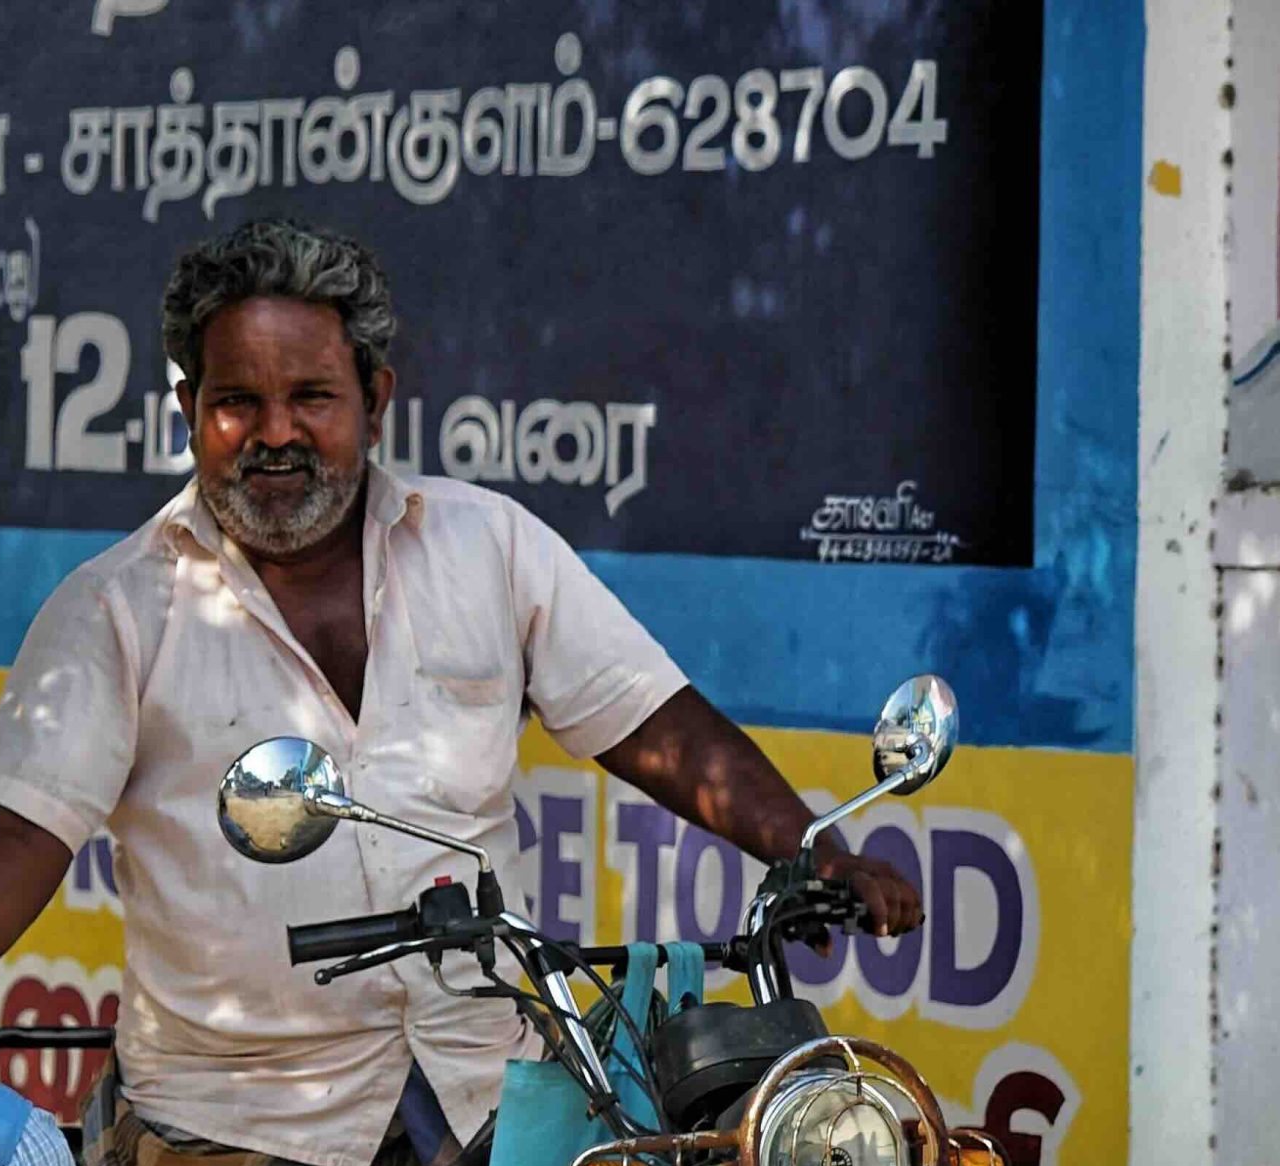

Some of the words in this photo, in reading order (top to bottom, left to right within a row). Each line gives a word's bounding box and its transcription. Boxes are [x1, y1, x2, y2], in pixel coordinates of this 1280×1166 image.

[61, 33, 949, 222] சாத்தான்குளம்-628704
[439, 394, 657, 518] வரை
[618, 803, 743, 970] TO
